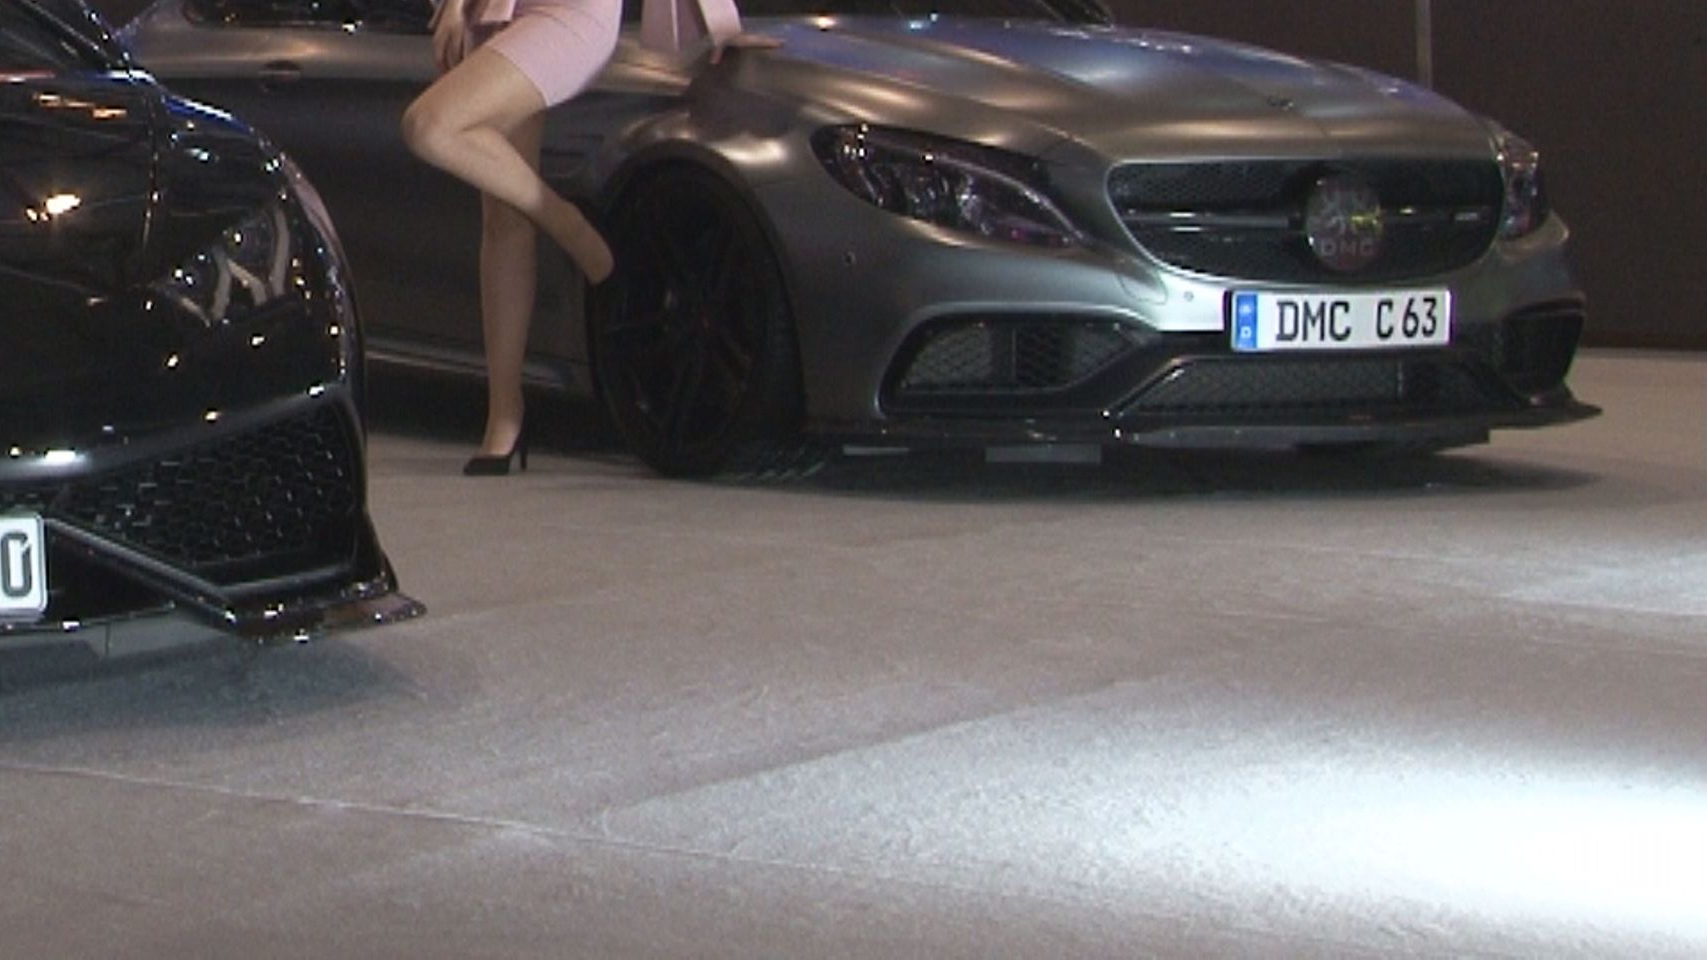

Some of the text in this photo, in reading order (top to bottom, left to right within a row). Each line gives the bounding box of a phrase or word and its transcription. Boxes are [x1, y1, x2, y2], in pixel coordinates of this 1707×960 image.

[1240, 326, 1252, 339] D
[1275, 296, 1438, 342] DMC C 63
